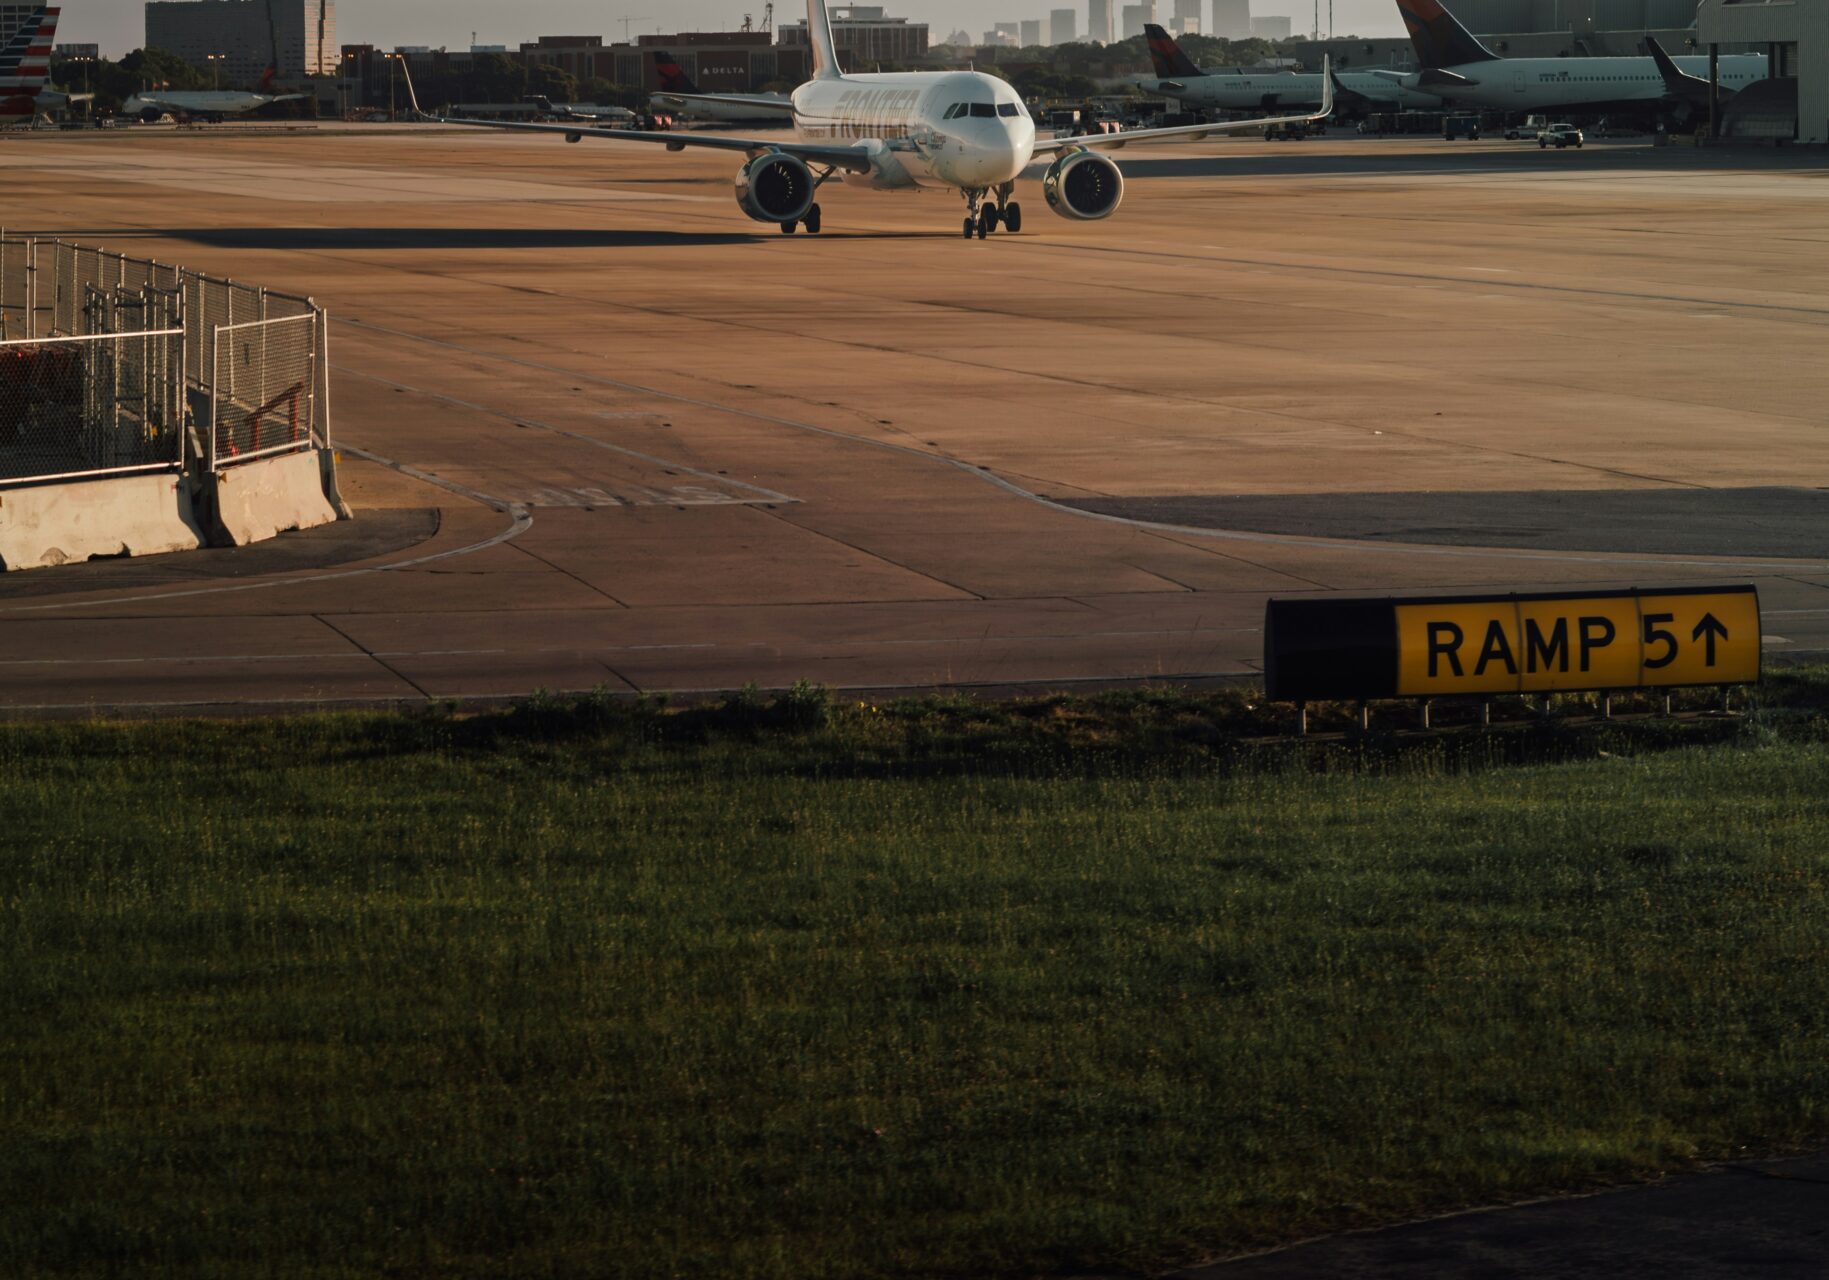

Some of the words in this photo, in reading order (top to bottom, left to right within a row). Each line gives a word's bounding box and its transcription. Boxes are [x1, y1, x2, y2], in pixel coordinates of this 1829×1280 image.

[711, 66, 745, 75] DELTA
[830, 89, 921, 140] FRONTIER
[1425, 616, 1616, 678] RAMP
[1642, 612, 1678, 670] 5
